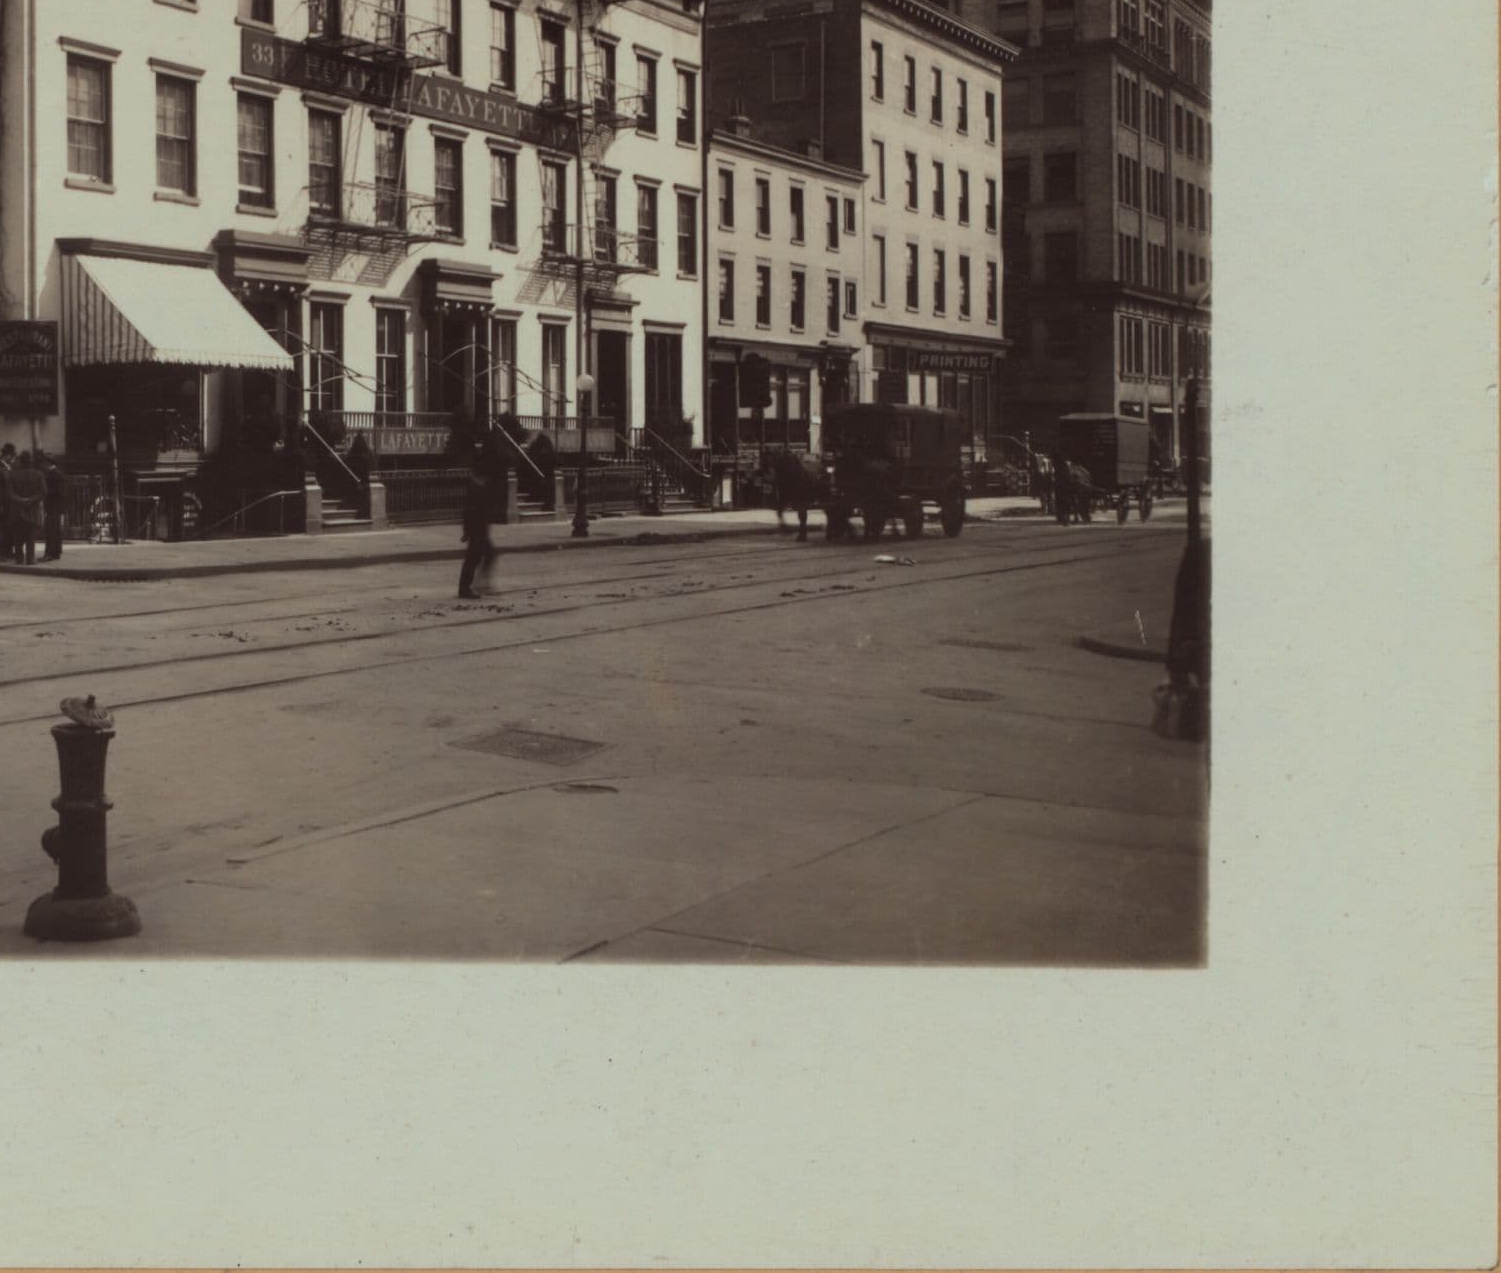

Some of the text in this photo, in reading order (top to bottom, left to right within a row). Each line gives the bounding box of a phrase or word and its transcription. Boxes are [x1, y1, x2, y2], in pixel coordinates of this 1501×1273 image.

[251, 42, 275, 69] 33
[919, 353, 990, 369] PRINTING
[380, 431, 451, 449] LAFAYETTE
